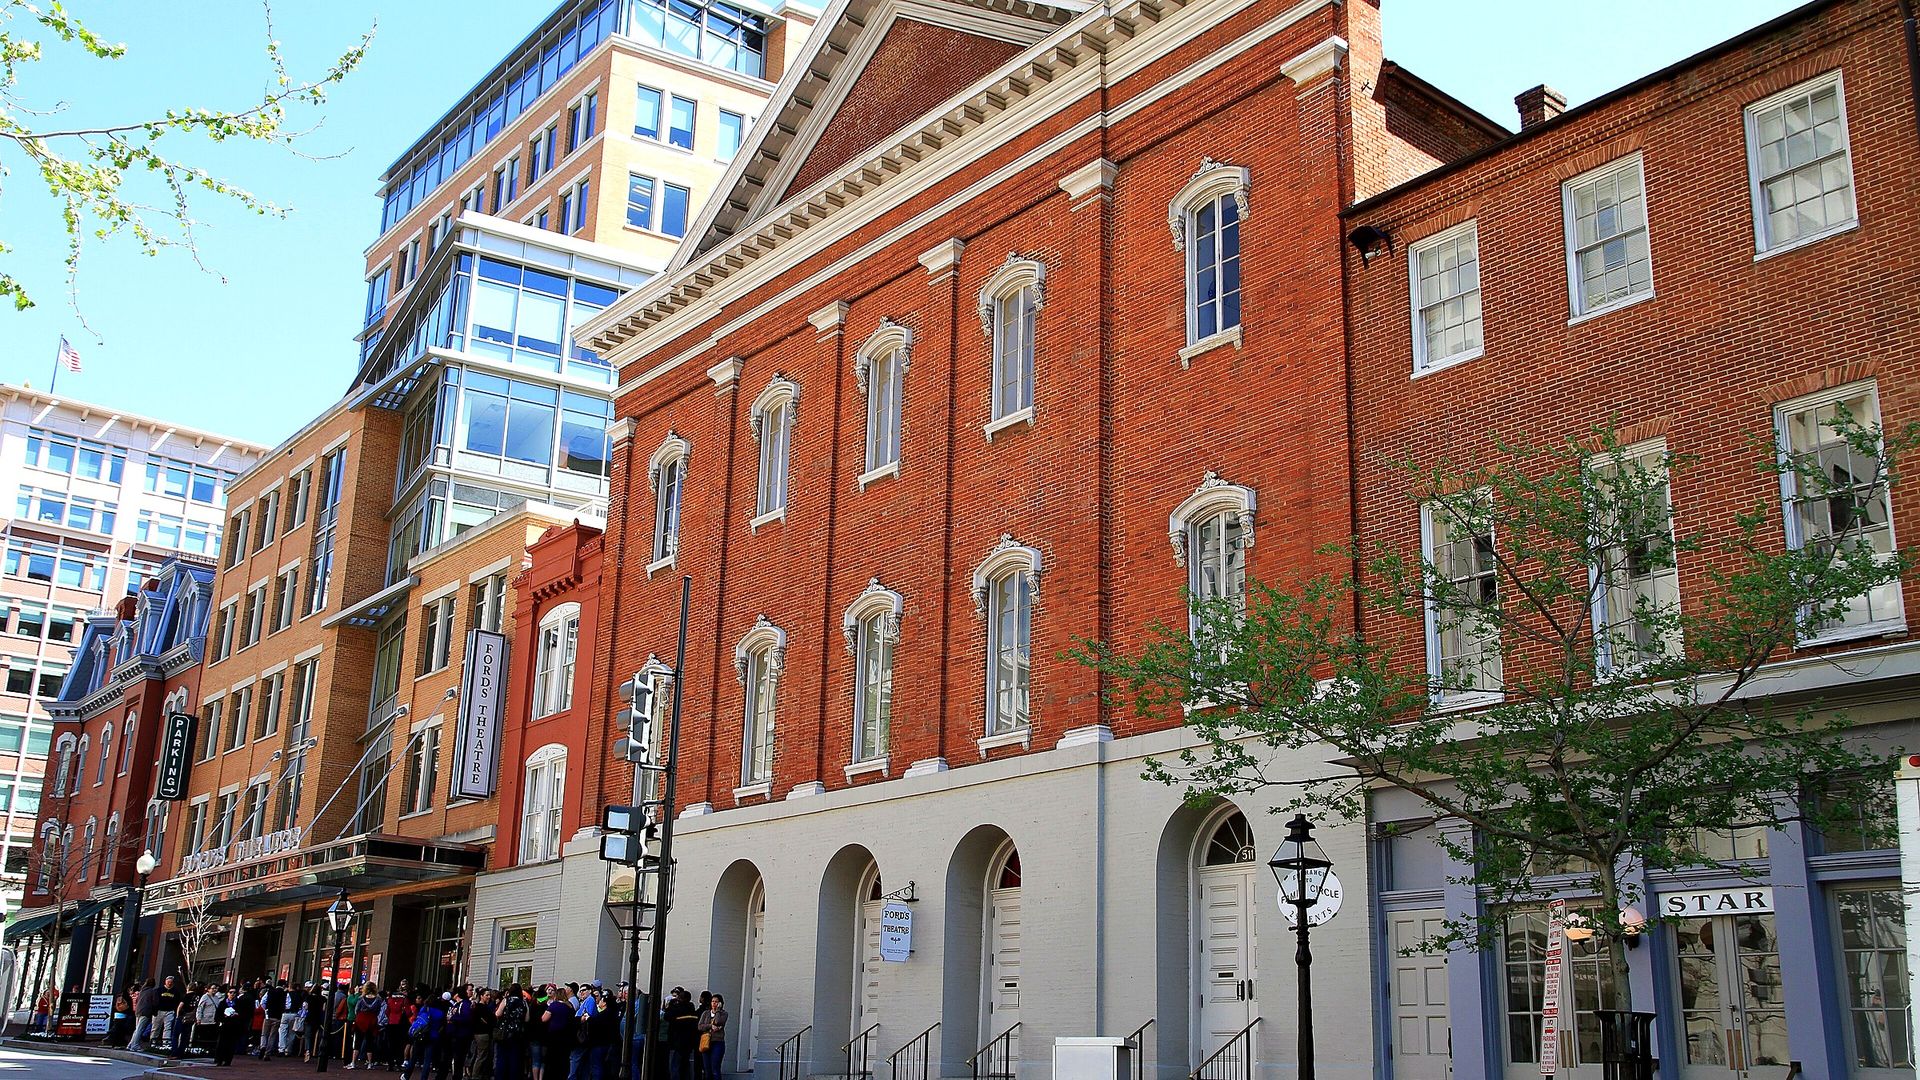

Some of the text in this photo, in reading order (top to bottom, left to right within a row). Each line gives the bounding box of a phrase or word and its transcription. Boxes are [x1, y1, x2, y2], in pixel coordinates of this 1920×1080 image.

[471, 704, 488, 784] THEATRE
[167, 720, 183, 786] PARKING
[1241, 849, 1254, 860] 511
[1310, 884, 1339, 898] CIRCLE
[1667, 892, 1768, 912] STAR
[884, 911, 910, 920] FORD'S
[1307, 906, 1333, 923] ENTS
[883, 925, 910, 935] THEATRE
